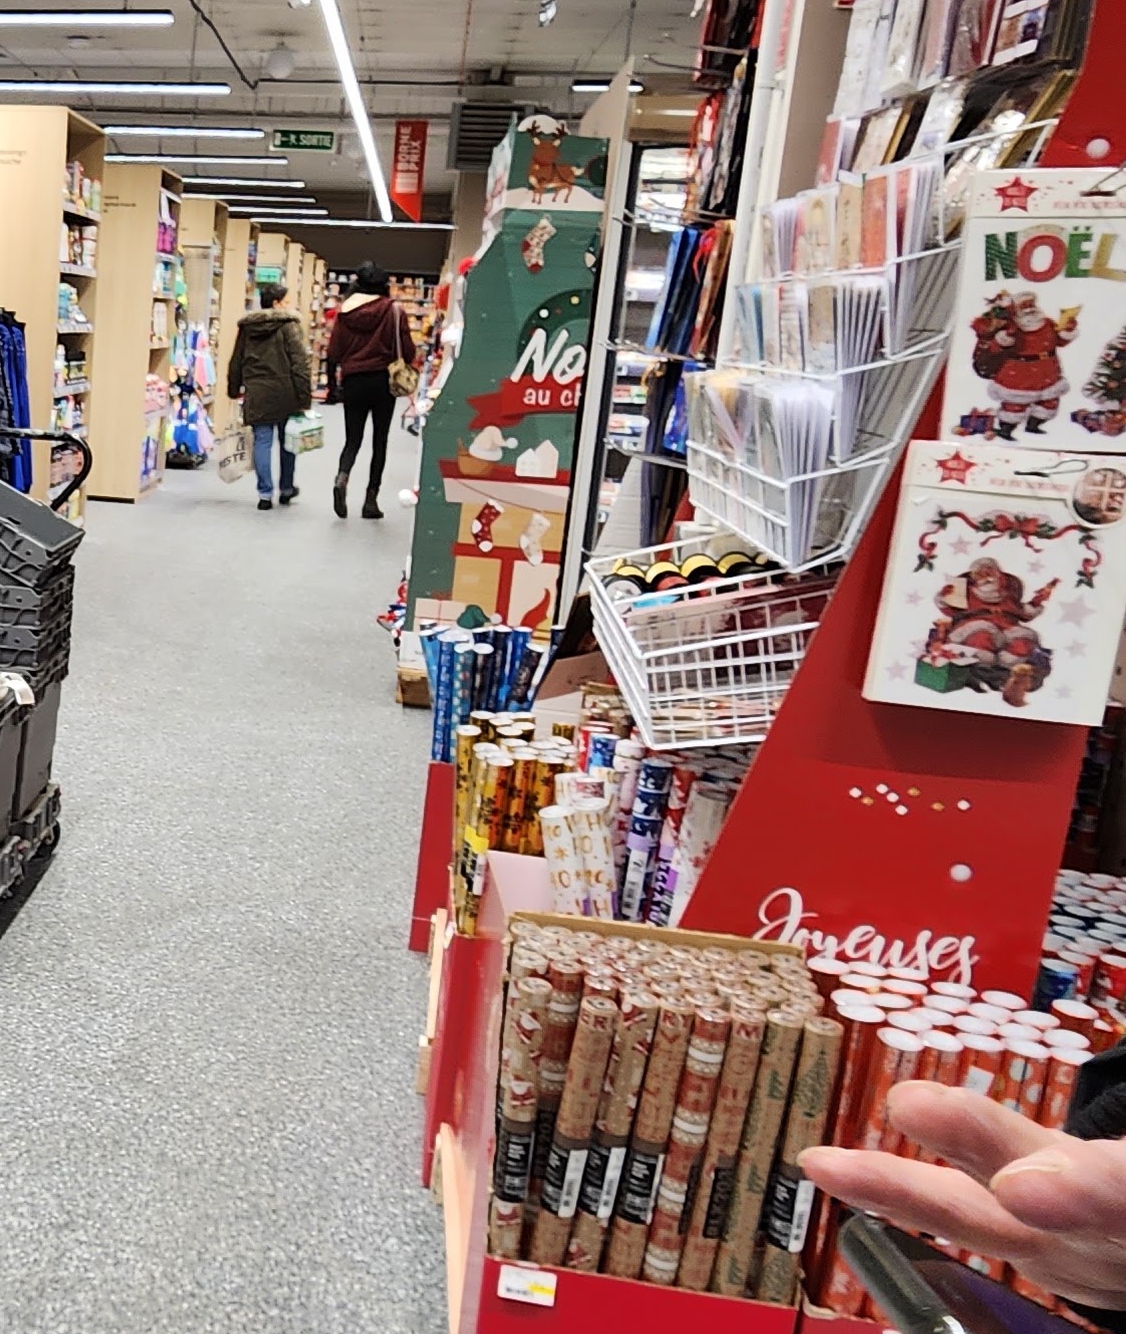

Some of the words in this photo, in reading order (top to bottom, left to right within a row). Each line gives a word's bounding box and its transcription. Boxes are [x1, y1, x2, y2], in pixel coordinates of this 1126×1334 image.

[299, 134, 333, 148] SORTIE
[408, 140, 423, 172] PRIX
[985, 224, 1126, 283] NOËL
[523, 387, 551, 406] au
[751, 887, 981, 986] Joyeuses
